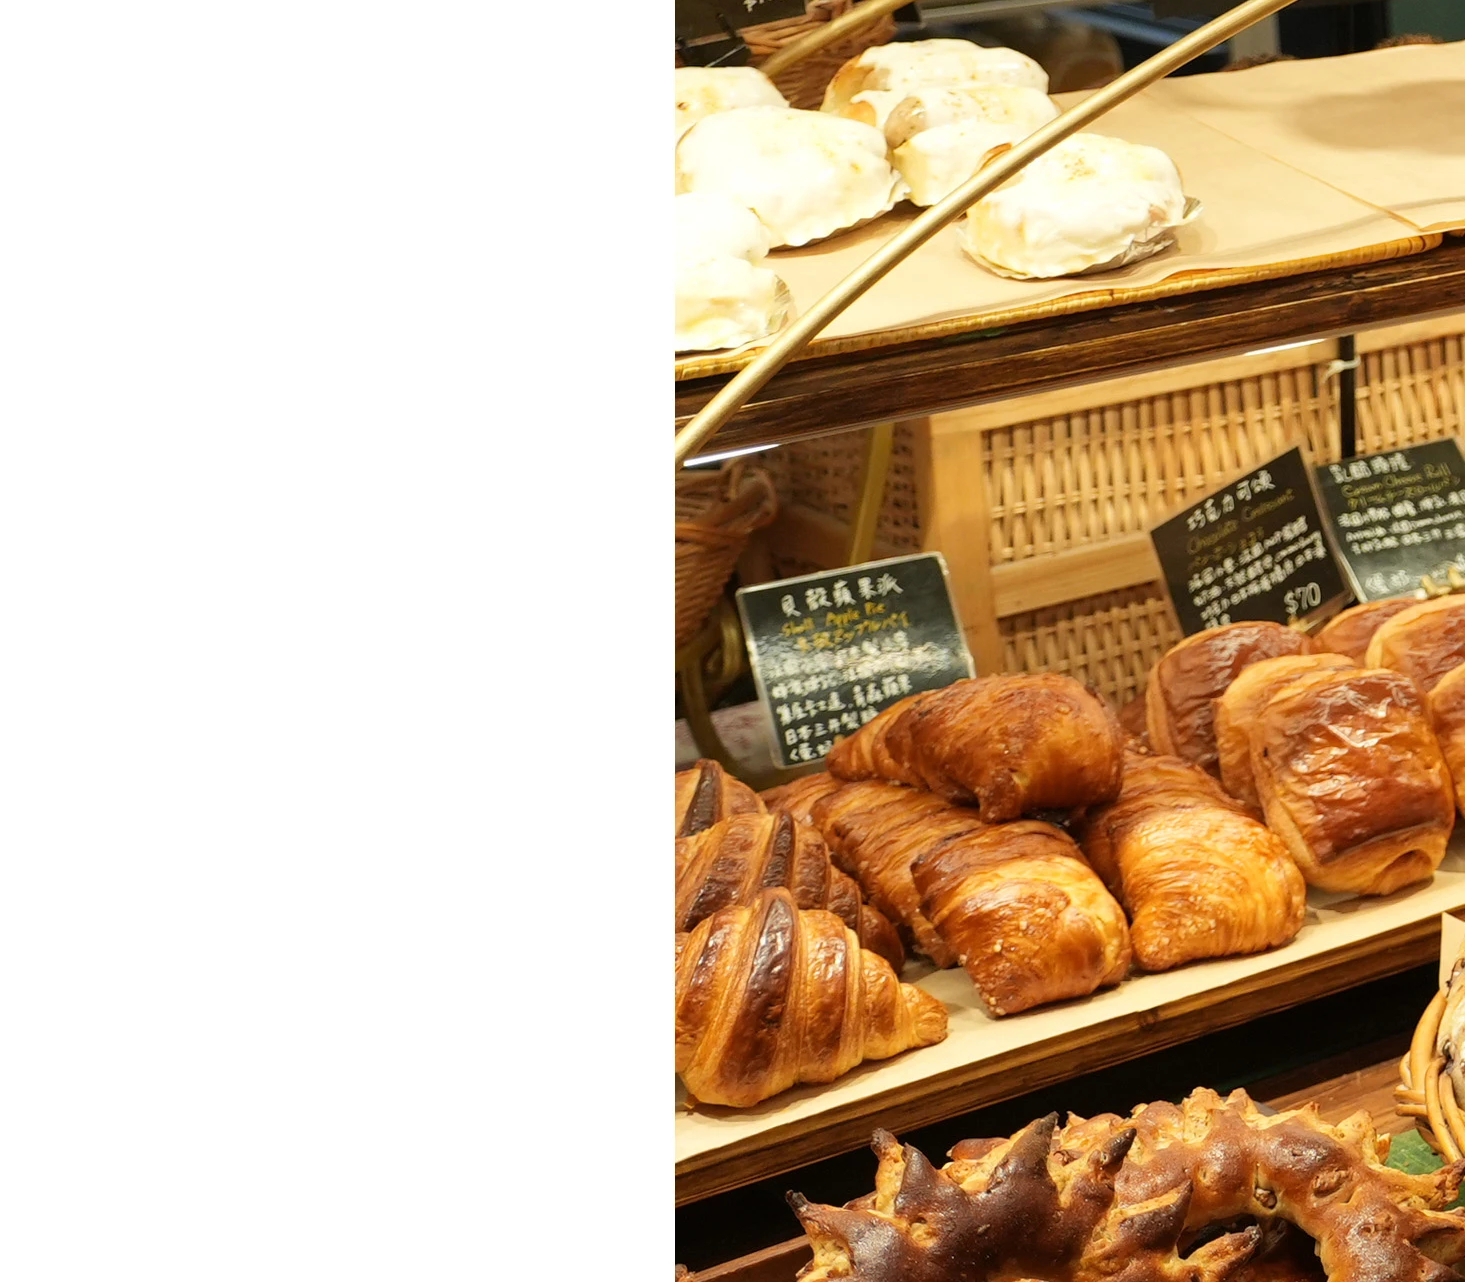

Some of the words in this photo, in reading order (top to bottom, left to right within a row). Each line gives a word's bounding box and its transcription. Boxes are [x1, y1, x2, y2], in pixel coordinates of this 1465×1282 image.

[1187, 469, 1276, 532] 巧克力可頌
[780, 572, 904, 617] 貝殼蘋果派
[1283, 582, 1322, 616] $70
[825, 607, 861, 629] Apple
